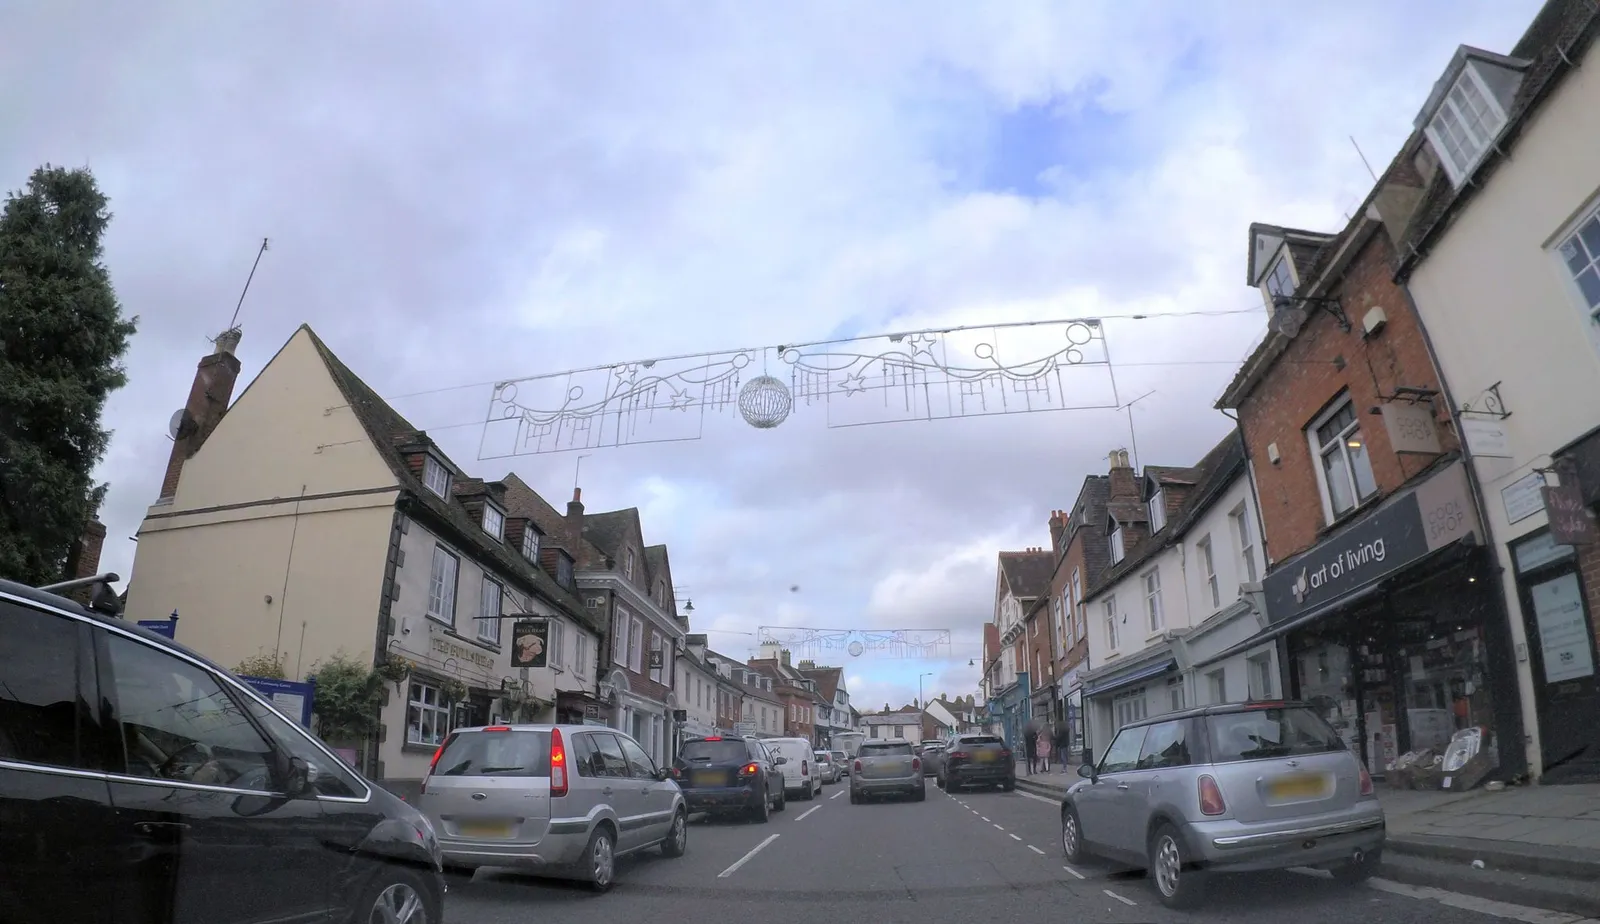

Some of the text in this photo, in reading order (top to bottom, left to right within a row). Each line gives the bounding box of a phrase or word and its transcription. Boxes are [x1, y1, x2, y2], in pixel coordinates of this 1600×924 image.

[1431, 511, 1464, 540] SHOP
[1310, 537, 1386, 589] art of living
